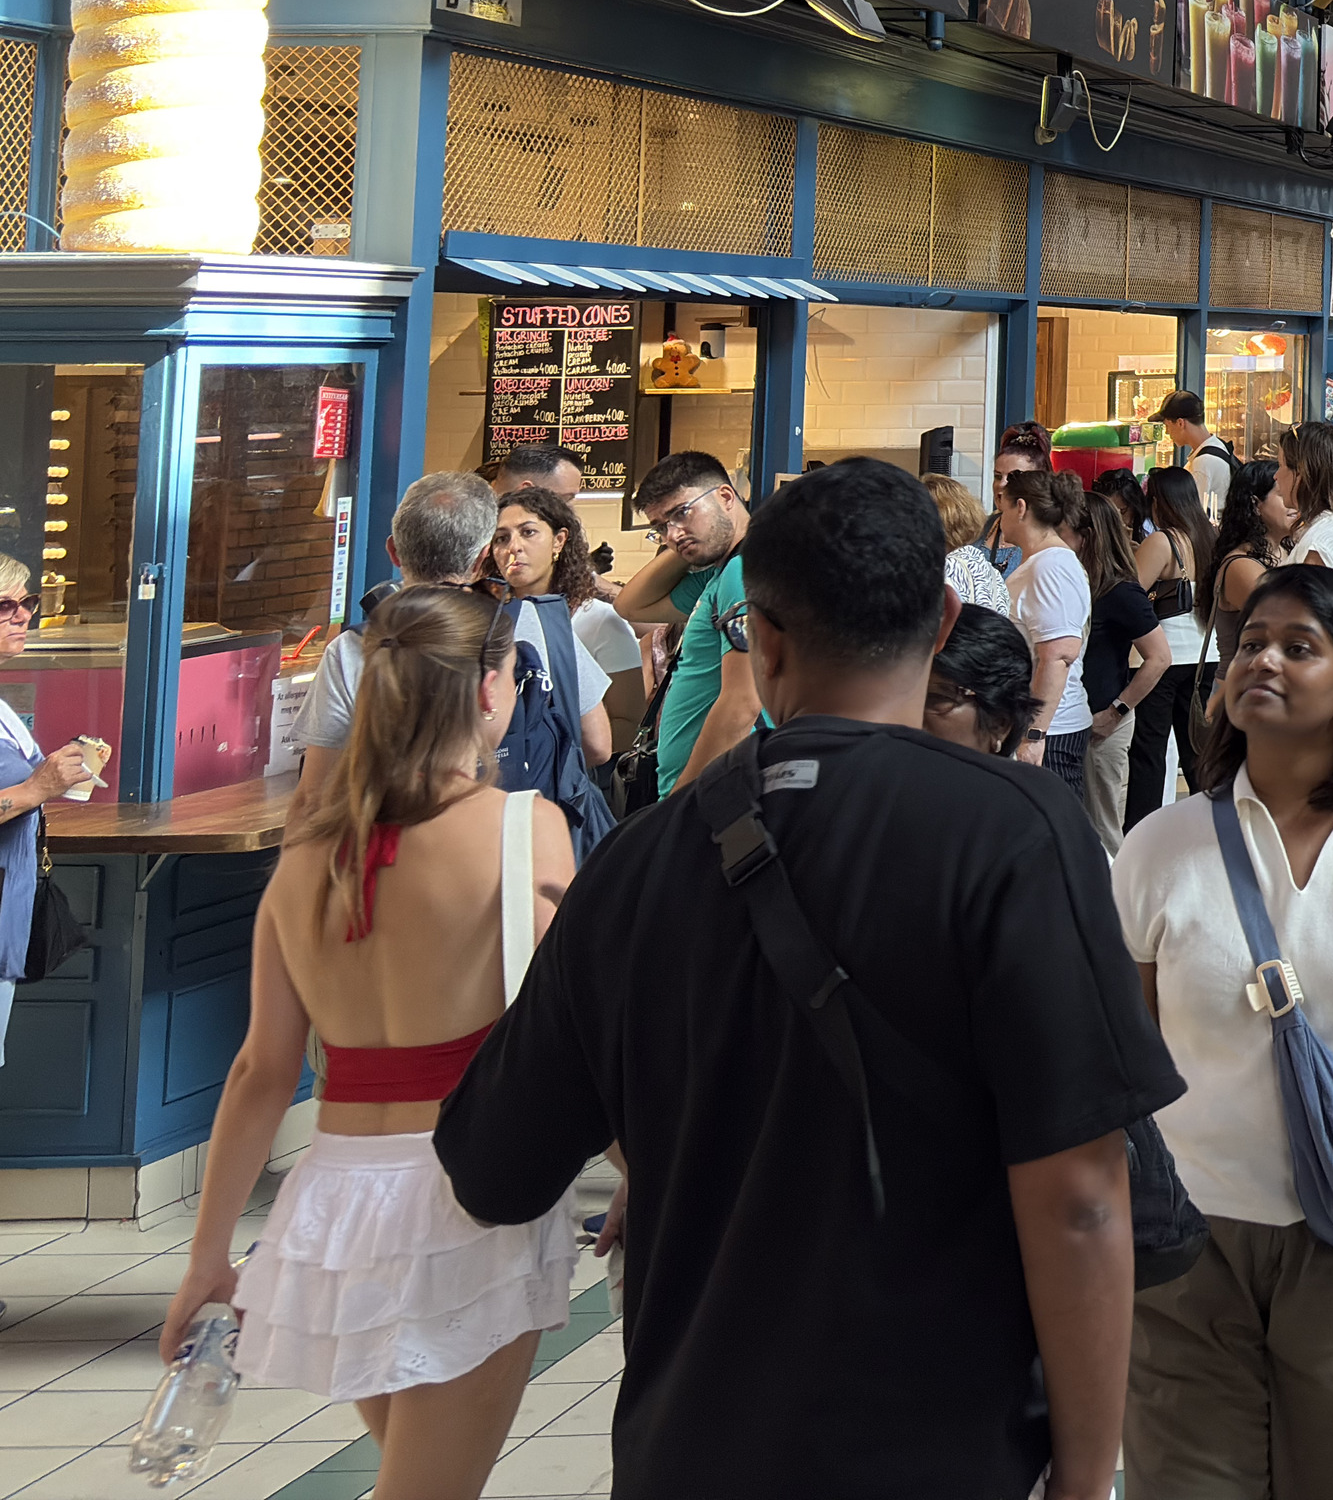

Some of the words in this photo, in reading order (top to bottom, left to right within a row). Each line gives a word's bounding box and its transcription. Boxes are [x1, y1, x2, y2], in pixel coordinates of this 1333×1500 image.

[501, 305, 580, 327] STUFFED
[582, 304, 631, 326] CONES
[513, 330, 553, 341] GRINCH:
[569, 329, 613, 340] TOFFEE:
[493, 378, 518, 390] OREO
[566, 377, 614, 390] UNICORN:
[562, 428, 600, 441] NUTELLA
